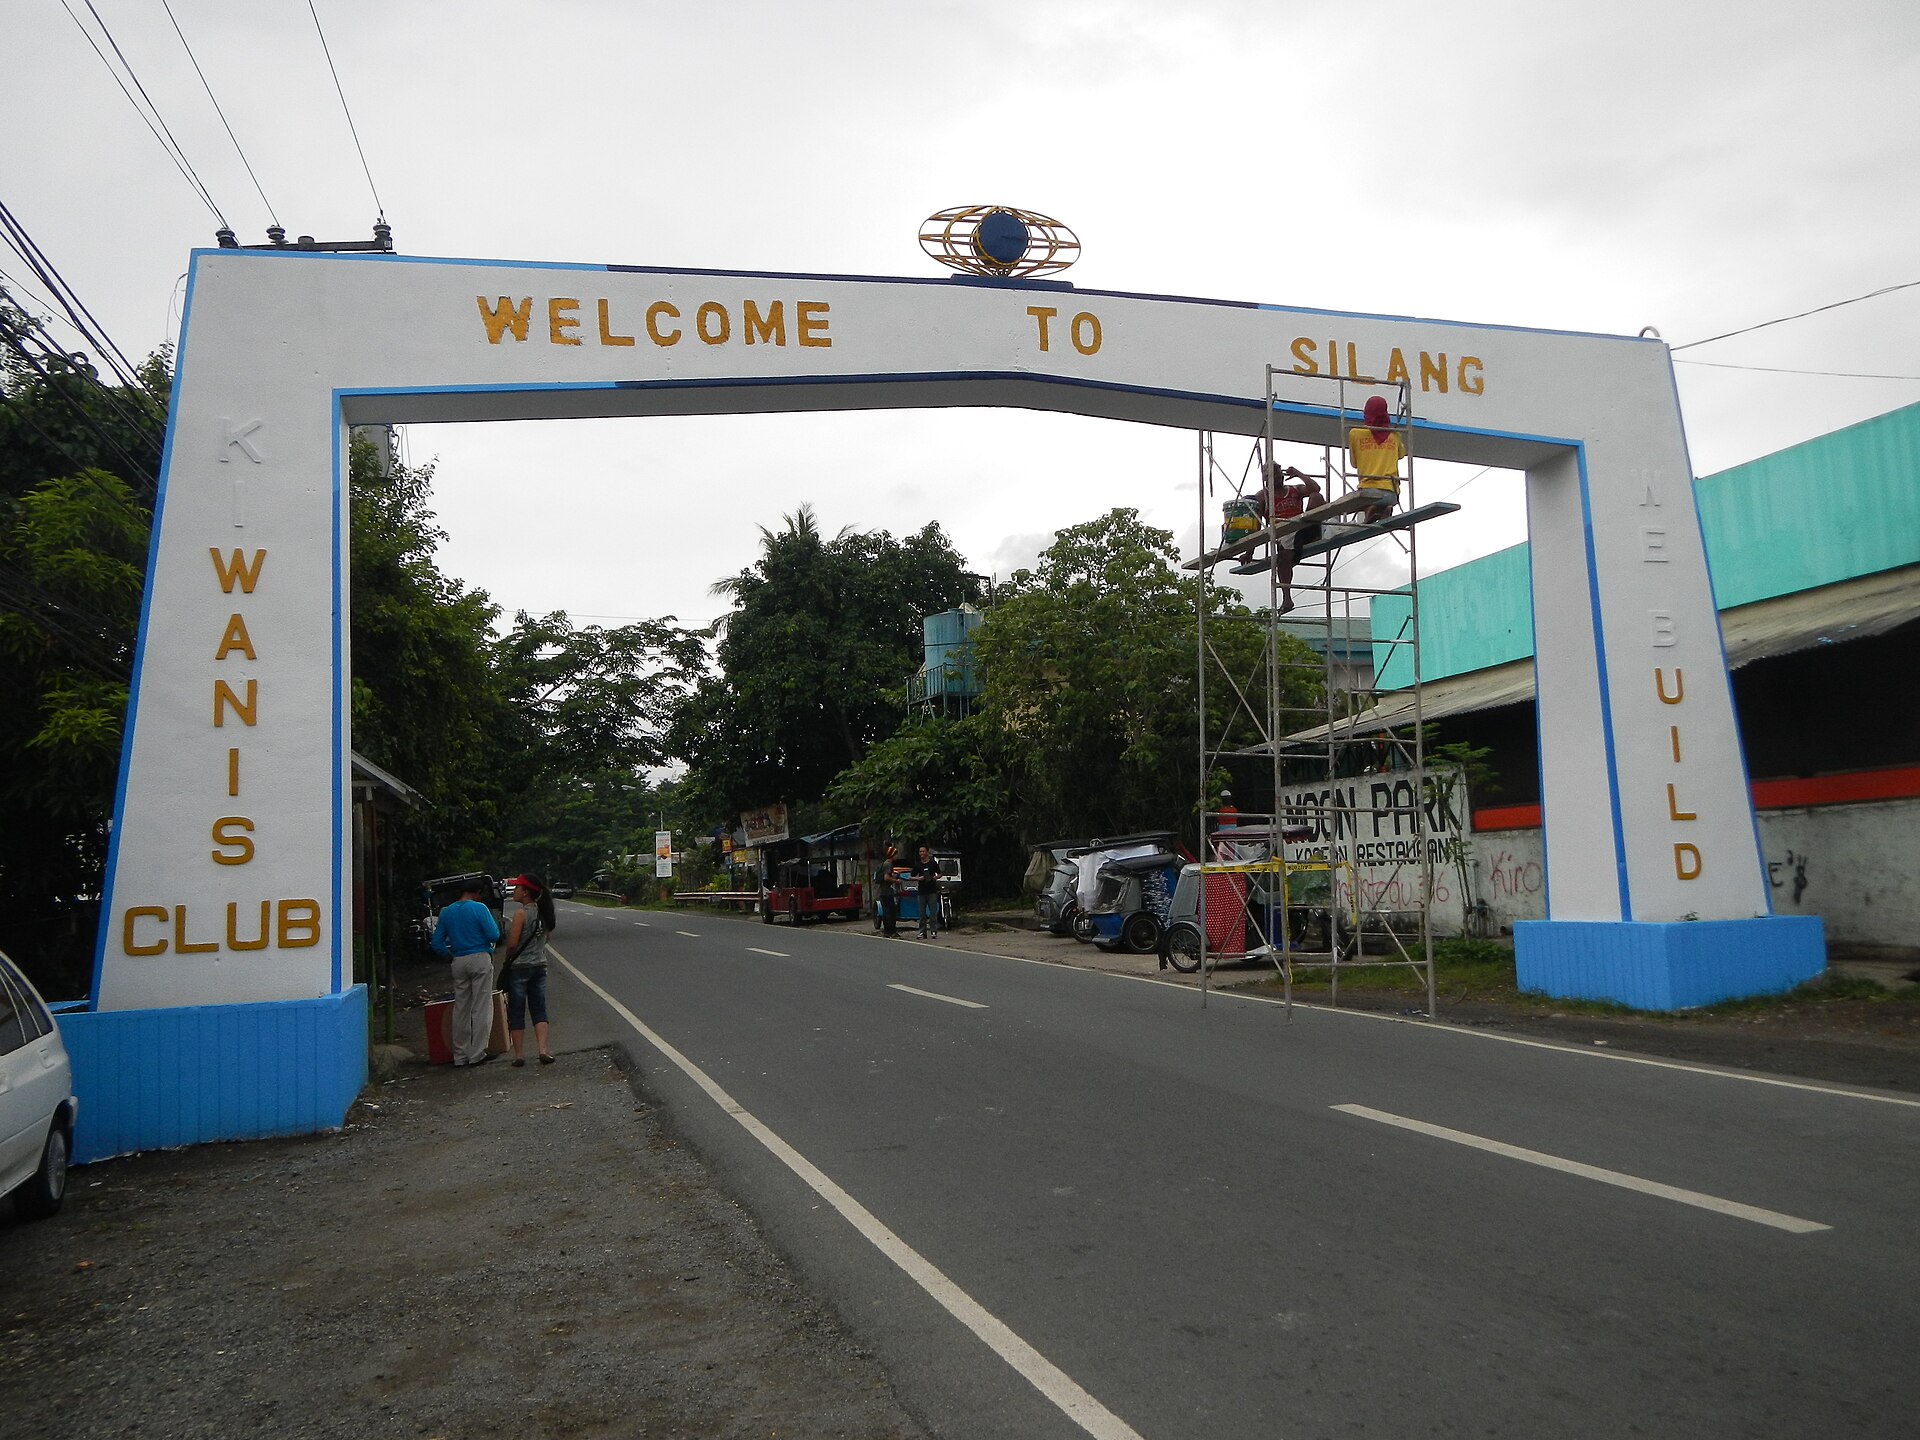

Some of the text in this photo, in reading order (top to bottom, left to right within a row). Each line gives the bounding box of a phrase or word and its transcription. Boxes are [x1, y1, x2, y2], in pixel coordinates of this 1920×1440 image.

[477, 297, 1484, 395] WELCOME TO SILANG
[209, 416, 267, 867] KIWANIS
[1647, 609, 1702, 881] BUILD
[1370, 772, 1463, 838] PARK
[1295, 845, 1348, 865] KOEN
[123, 898, 321, 955] CLUB
